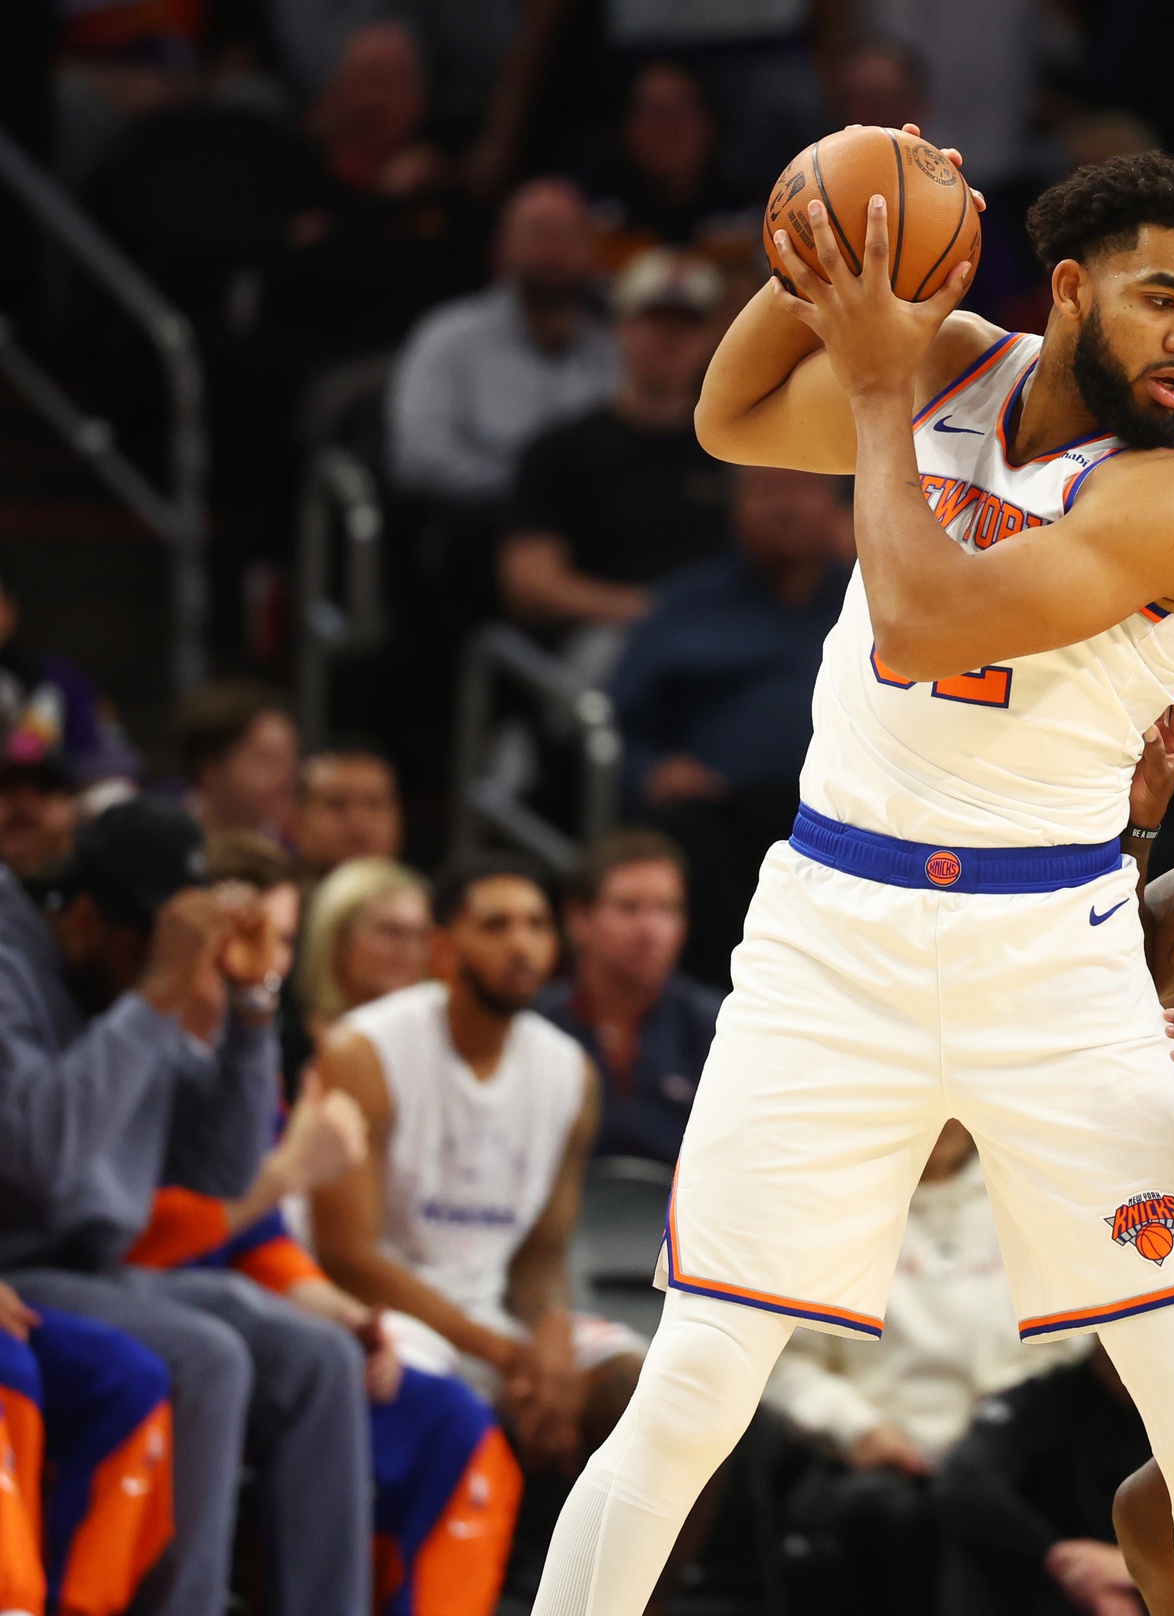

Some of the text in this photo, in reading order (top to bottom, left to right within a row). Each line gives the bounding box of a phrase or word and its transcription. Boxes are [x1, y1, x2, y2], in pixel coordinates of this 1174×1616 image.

[918, 474, 984, 531] EW
[929, 860, 957, 877] KNICKS
[1128, 1191, 1162, 1206] NEW YORK
